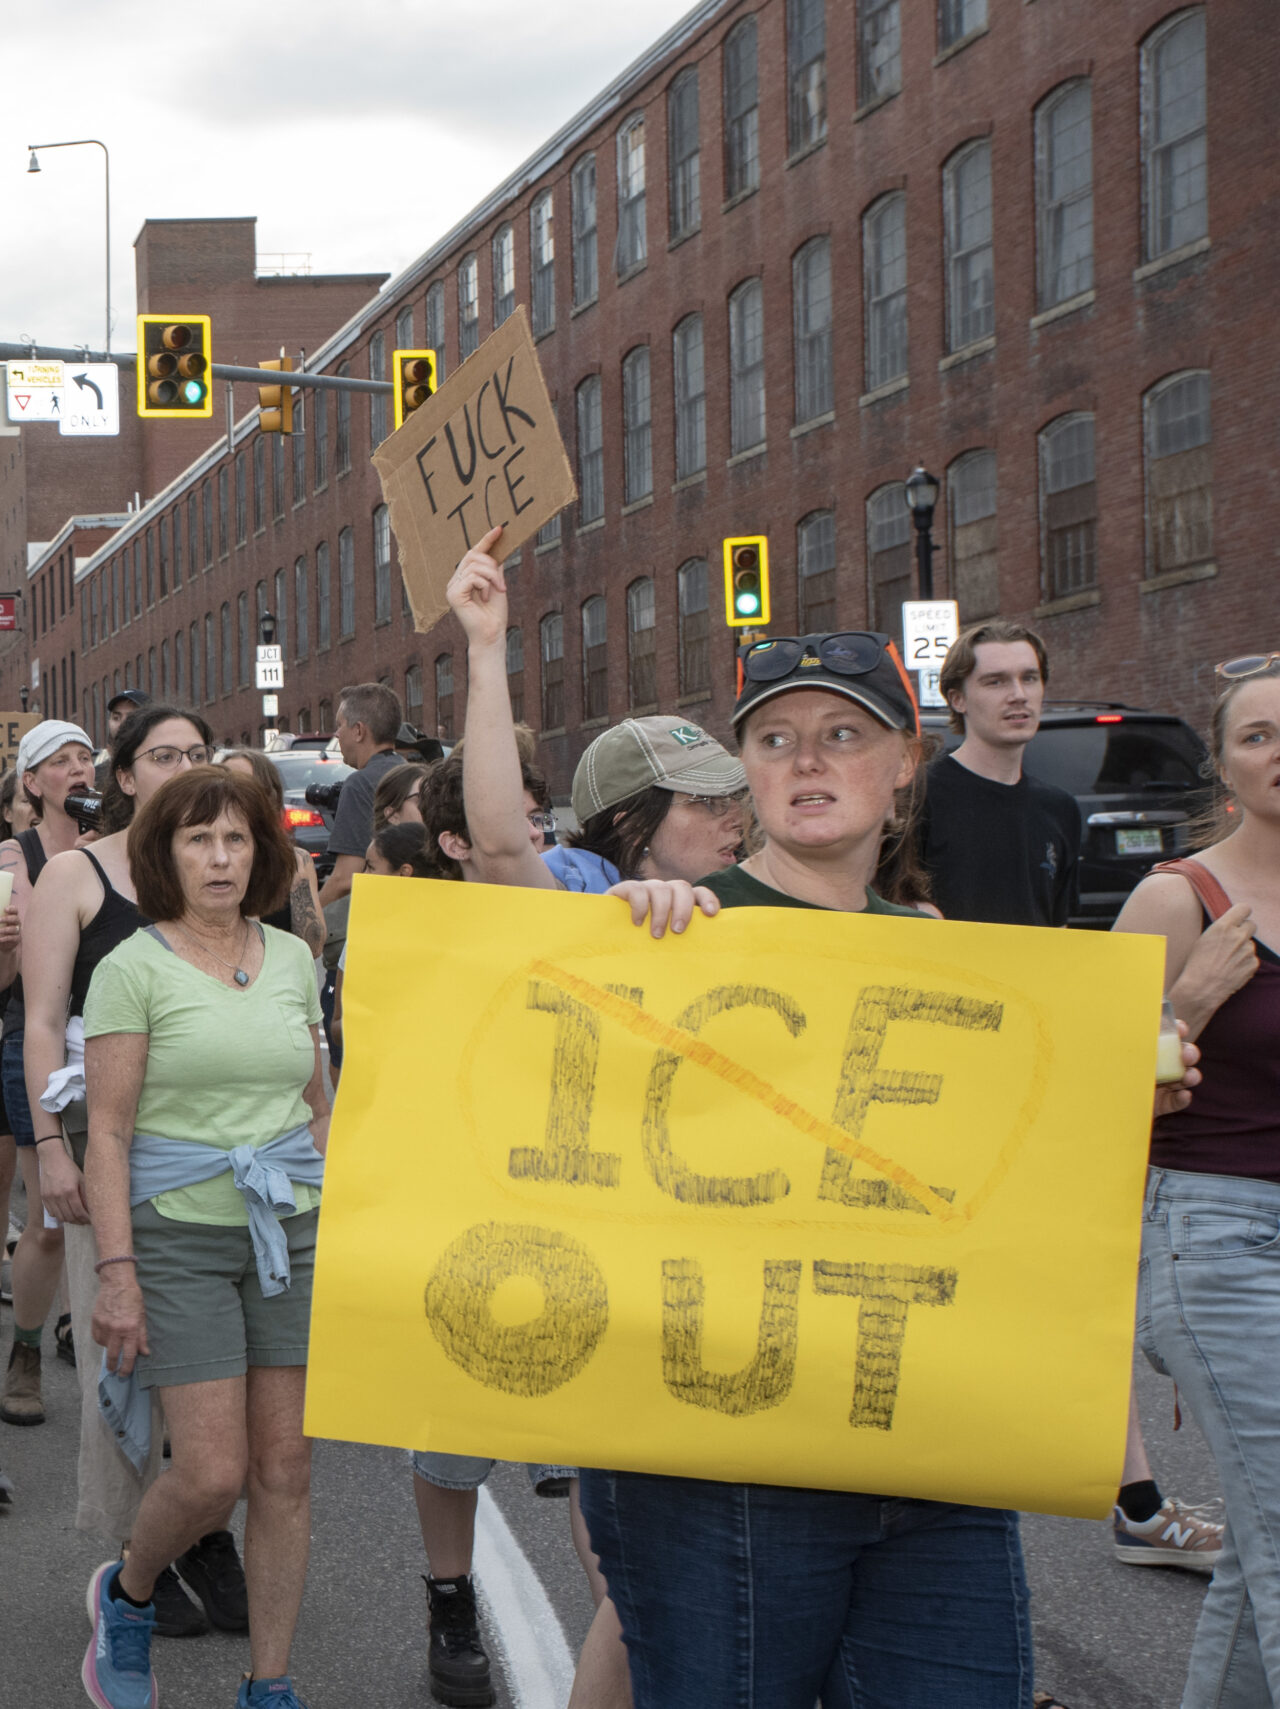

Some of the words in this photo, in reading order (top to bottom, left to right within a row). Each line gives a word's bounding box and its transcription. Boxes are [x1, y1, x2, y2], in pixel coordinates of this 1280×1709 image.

[70, 415, 108, 428] ONLY
[416, 356, 536, 514] FUCK
[447, 446, 535, 569] ICE
[910, 609, 952, 620] SPEED
[914, 623, 947, 633] LIMIT
[261, 647, 278, 660] JCT
[913, 636, 950, 659] 25
[262, 668, 279, 682] 111
[671, 727, 699, 745] K
[507, 977, 1005, 1215] ICE
[423, 1221, 959, 1433] OUT
[1161, 1521, 1195, 1548] N
